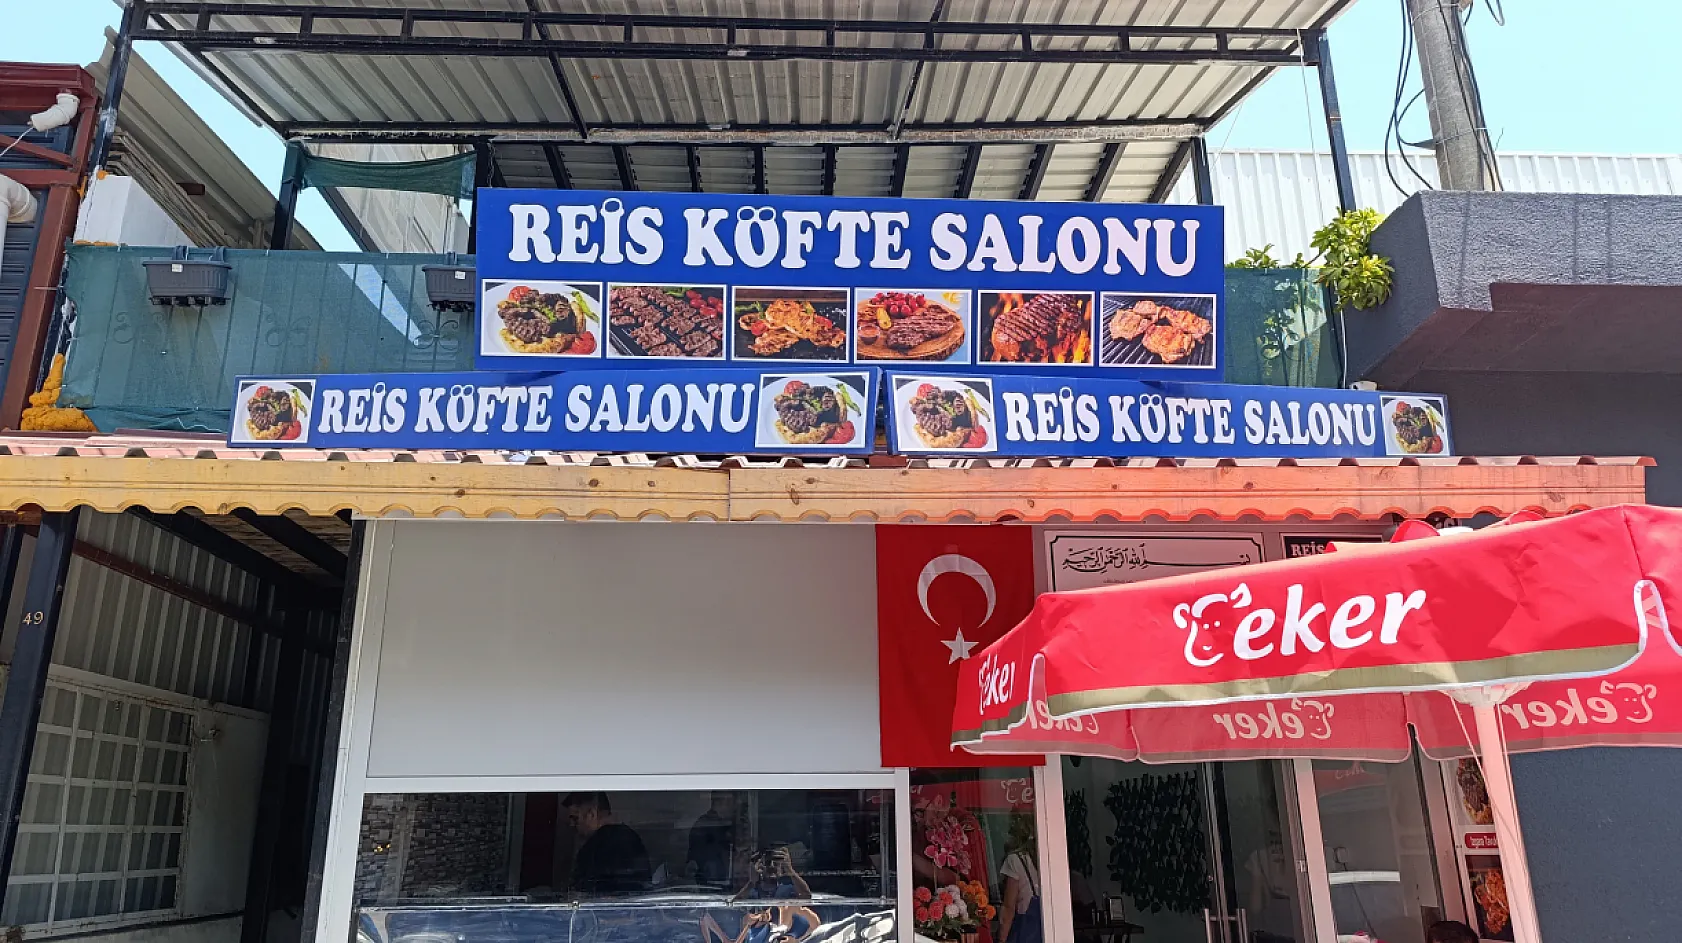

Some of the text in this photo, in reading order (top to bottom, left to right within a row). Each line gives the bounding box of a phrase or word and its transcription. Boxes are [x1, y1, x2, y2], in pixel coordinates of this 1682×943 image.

[509, 198, 1199, 276] REİS KÖFTE SALONU
[318, 382, 755, 433] REİS KÖFTE SALONU
[1003, 387, 1375, 445] REİS KÖFTE SALONU
[22, 611, 44, 625] 49
